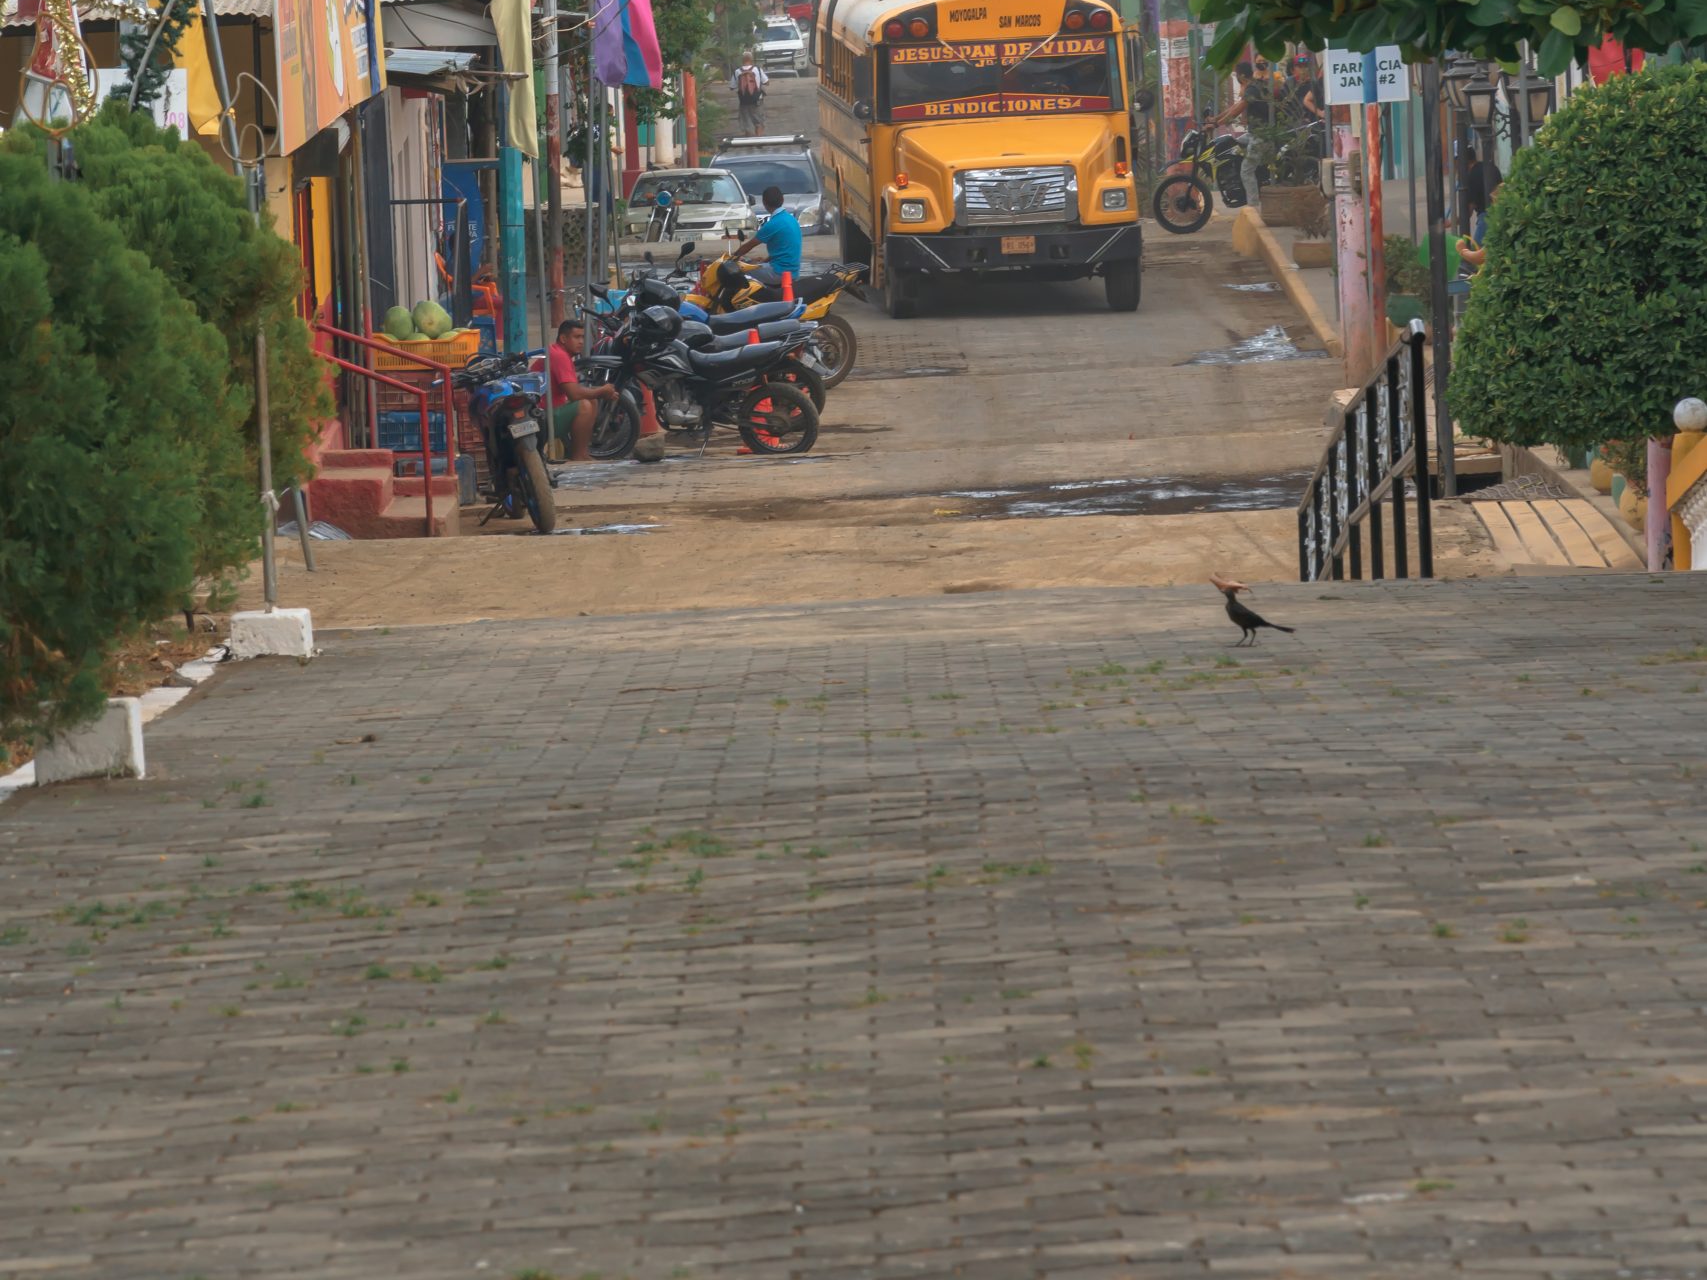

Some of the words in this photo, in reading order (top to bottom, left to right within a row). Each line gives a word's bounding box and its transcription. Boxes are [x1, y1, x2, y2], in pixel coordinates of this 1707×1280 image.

[949, 7, 987, 23] MOYOGALPA
[999, 15, 1012, 28] SAN
[1015, 14, 1041, 28] MARCOS
[894, 46, 953, 62] JESUS
[1041, 39, 1096, 54] VIDA
[1333, 59, 1402, 74] FARCIA
[1340, 76, 1365, 87] JAN
[1379, 73, 1396, 84] #2
[924, 97, 1072, 116] BENDICIONES
